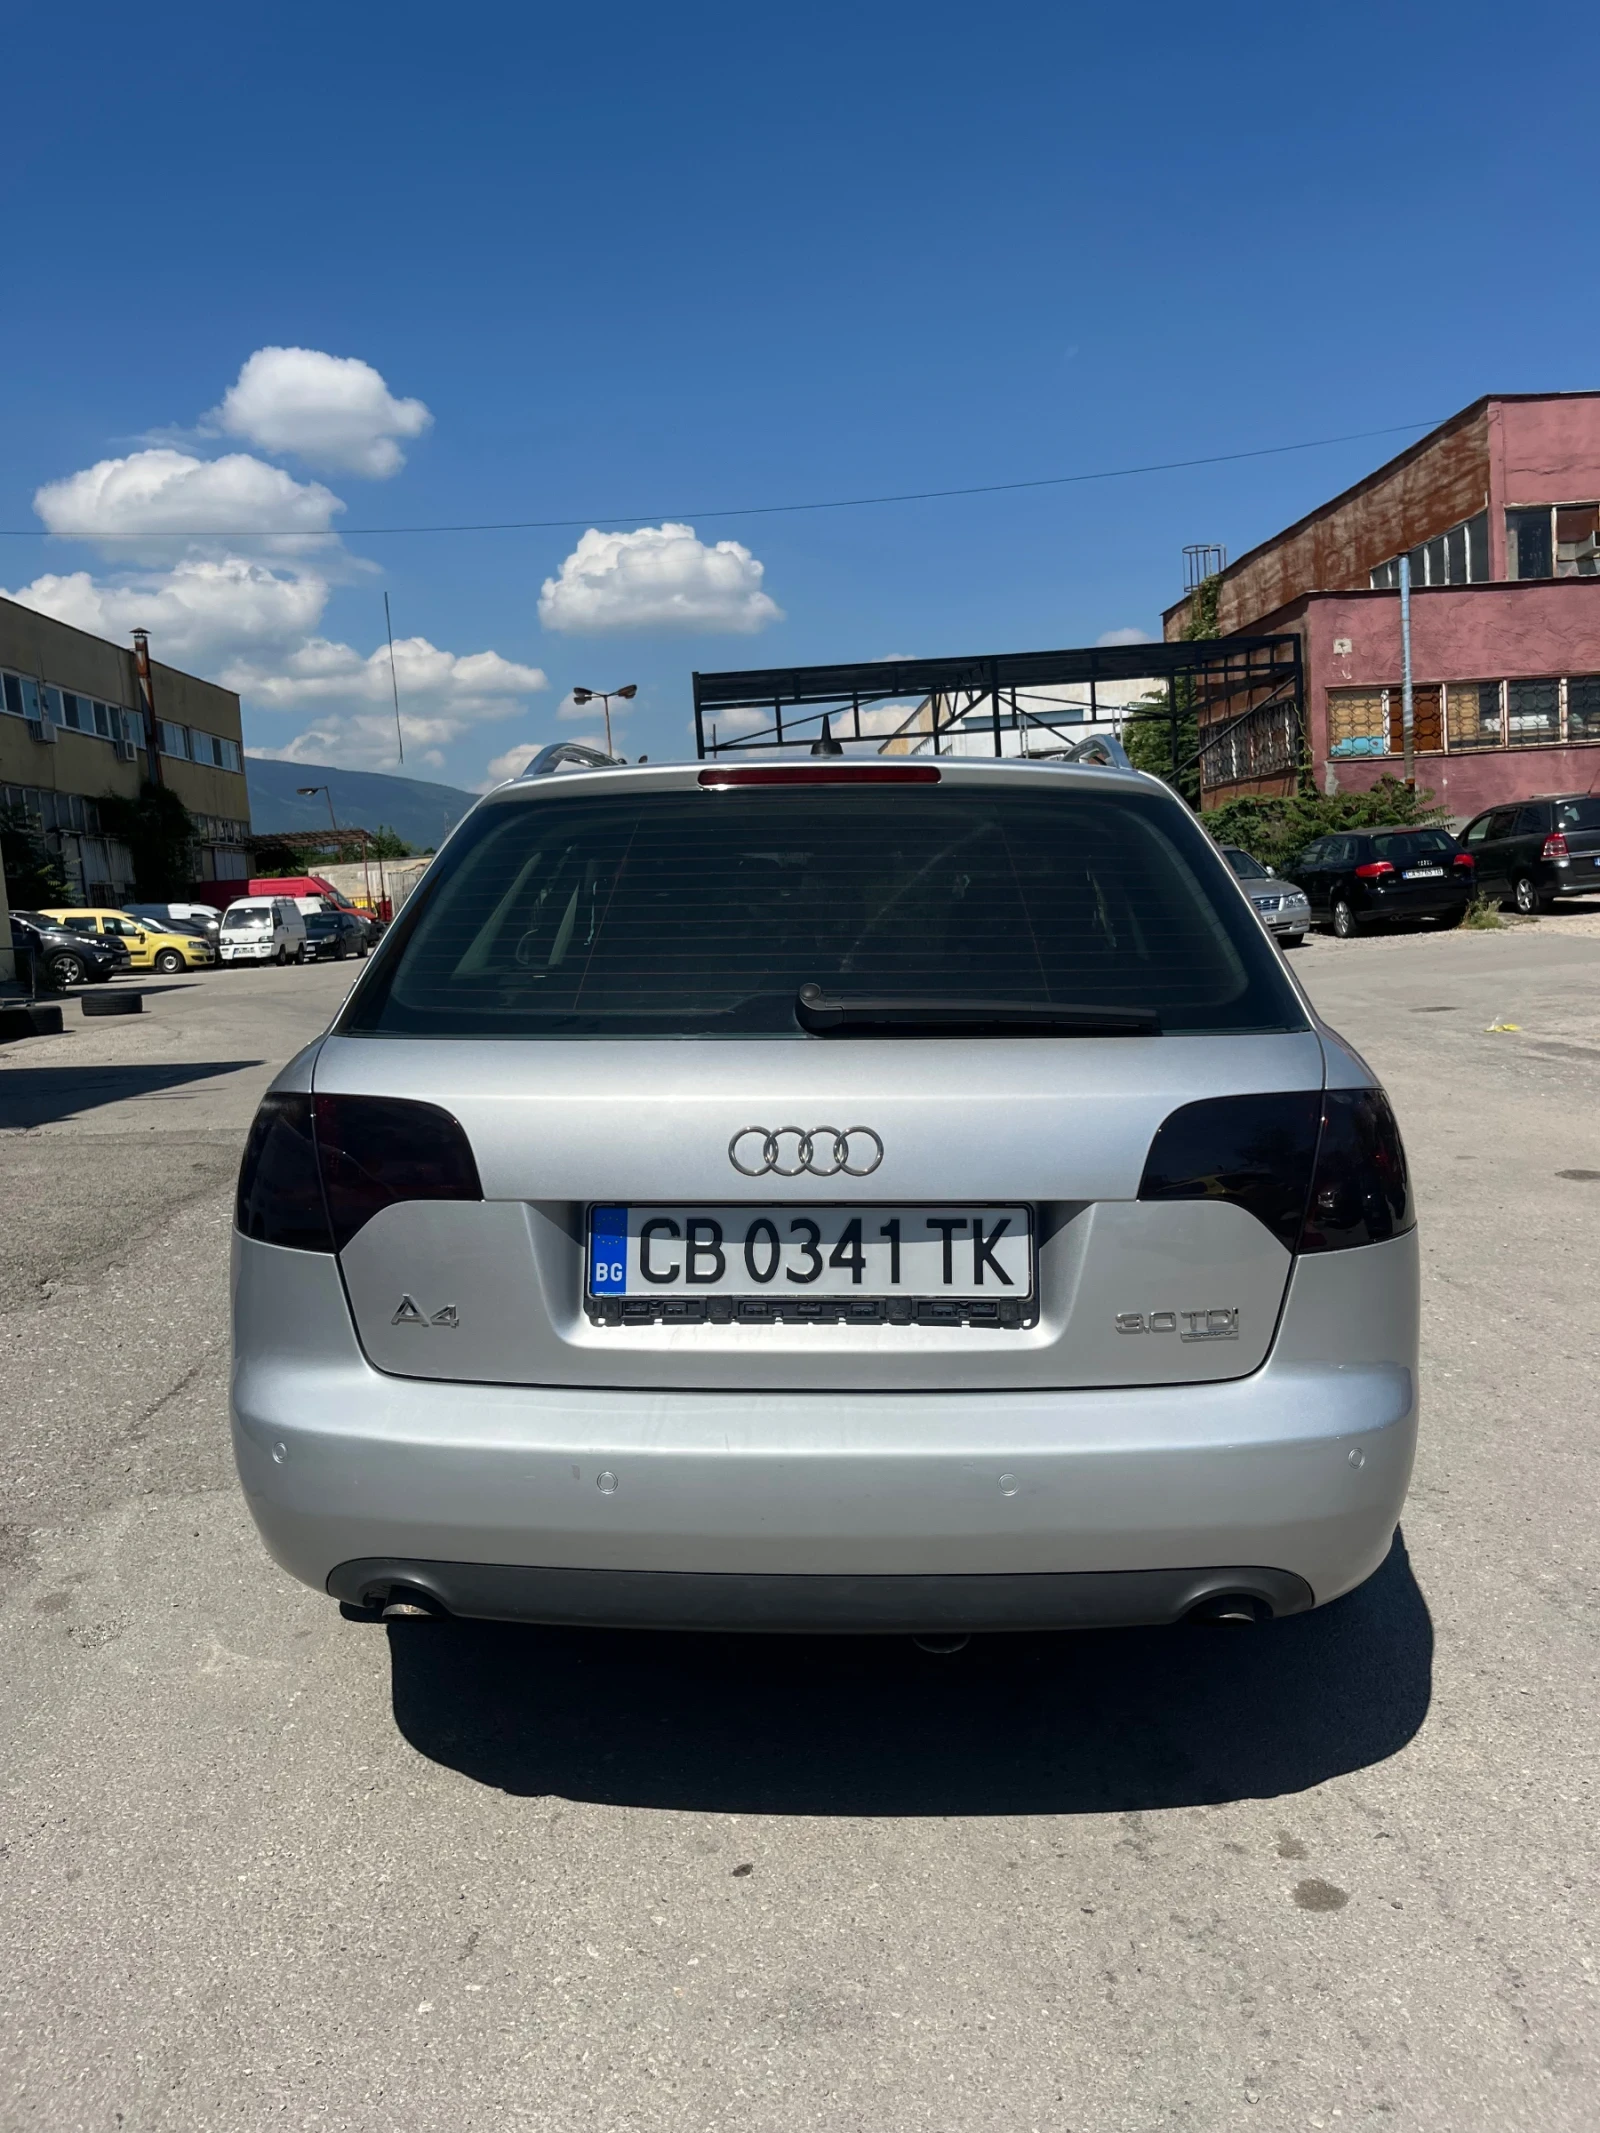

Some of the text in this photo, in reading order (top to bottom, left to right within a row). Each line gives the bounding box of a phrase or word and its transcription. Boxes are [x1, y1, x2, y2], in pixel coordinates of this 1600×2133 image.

[640, 1218, 1014, 1285] CB 0341 TK
[596, 1262, 623, 1282] BG
[391, 1293, 460, 1329] A4
[1115, 1307, 1239, 1335] 3.0 TDI
